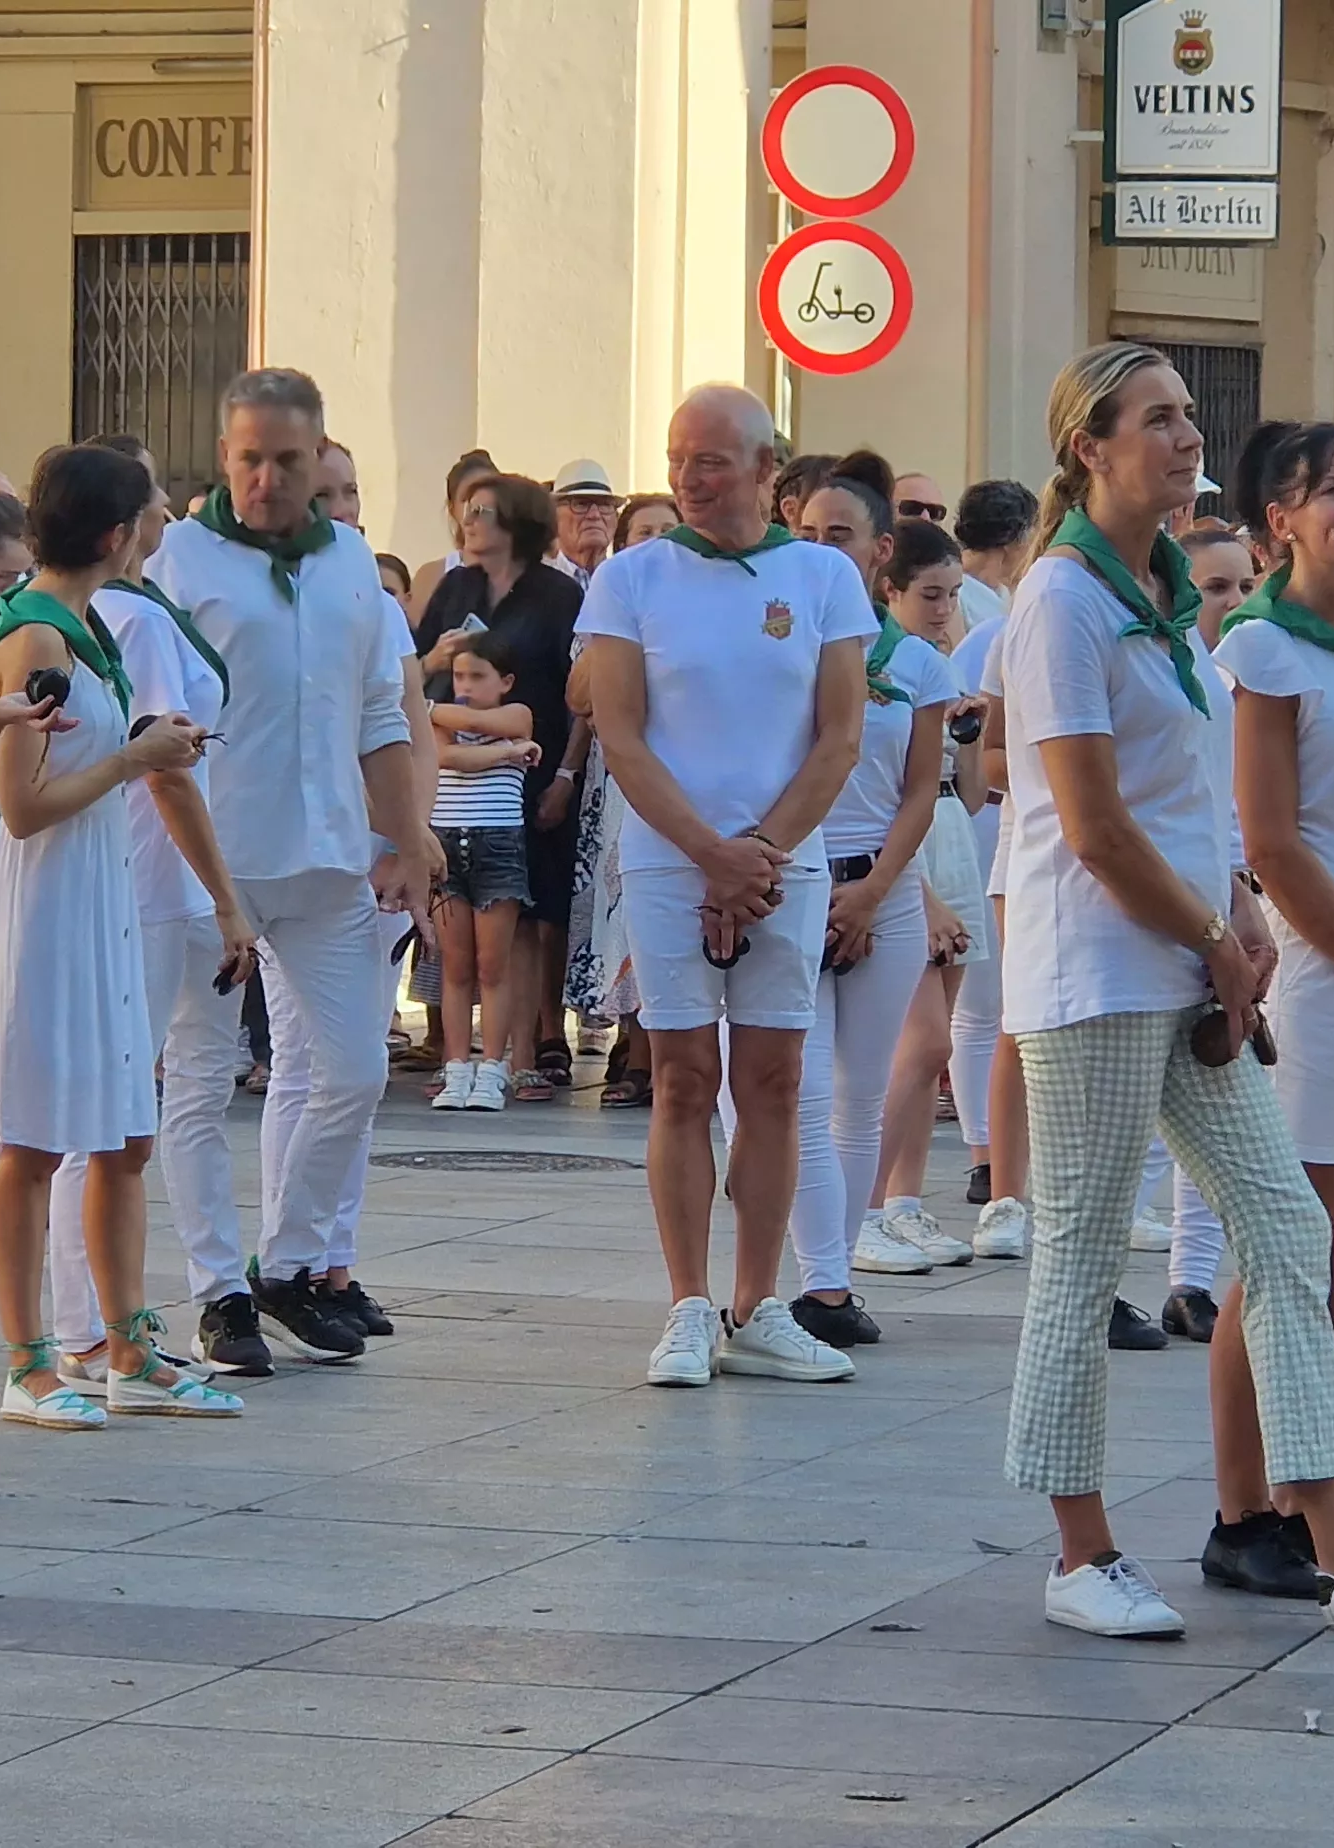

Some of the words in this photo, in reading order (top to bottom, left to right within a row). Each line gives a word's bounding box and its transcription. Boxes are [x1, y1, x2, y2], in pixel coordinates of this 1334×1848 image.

[1134, 85, 1255, 114] VELTINS
[95, 116, 252, 178] CONFE
[1125, 194, 1168, 224] Alt
[1176, 195, 1263, 225] Berlin
